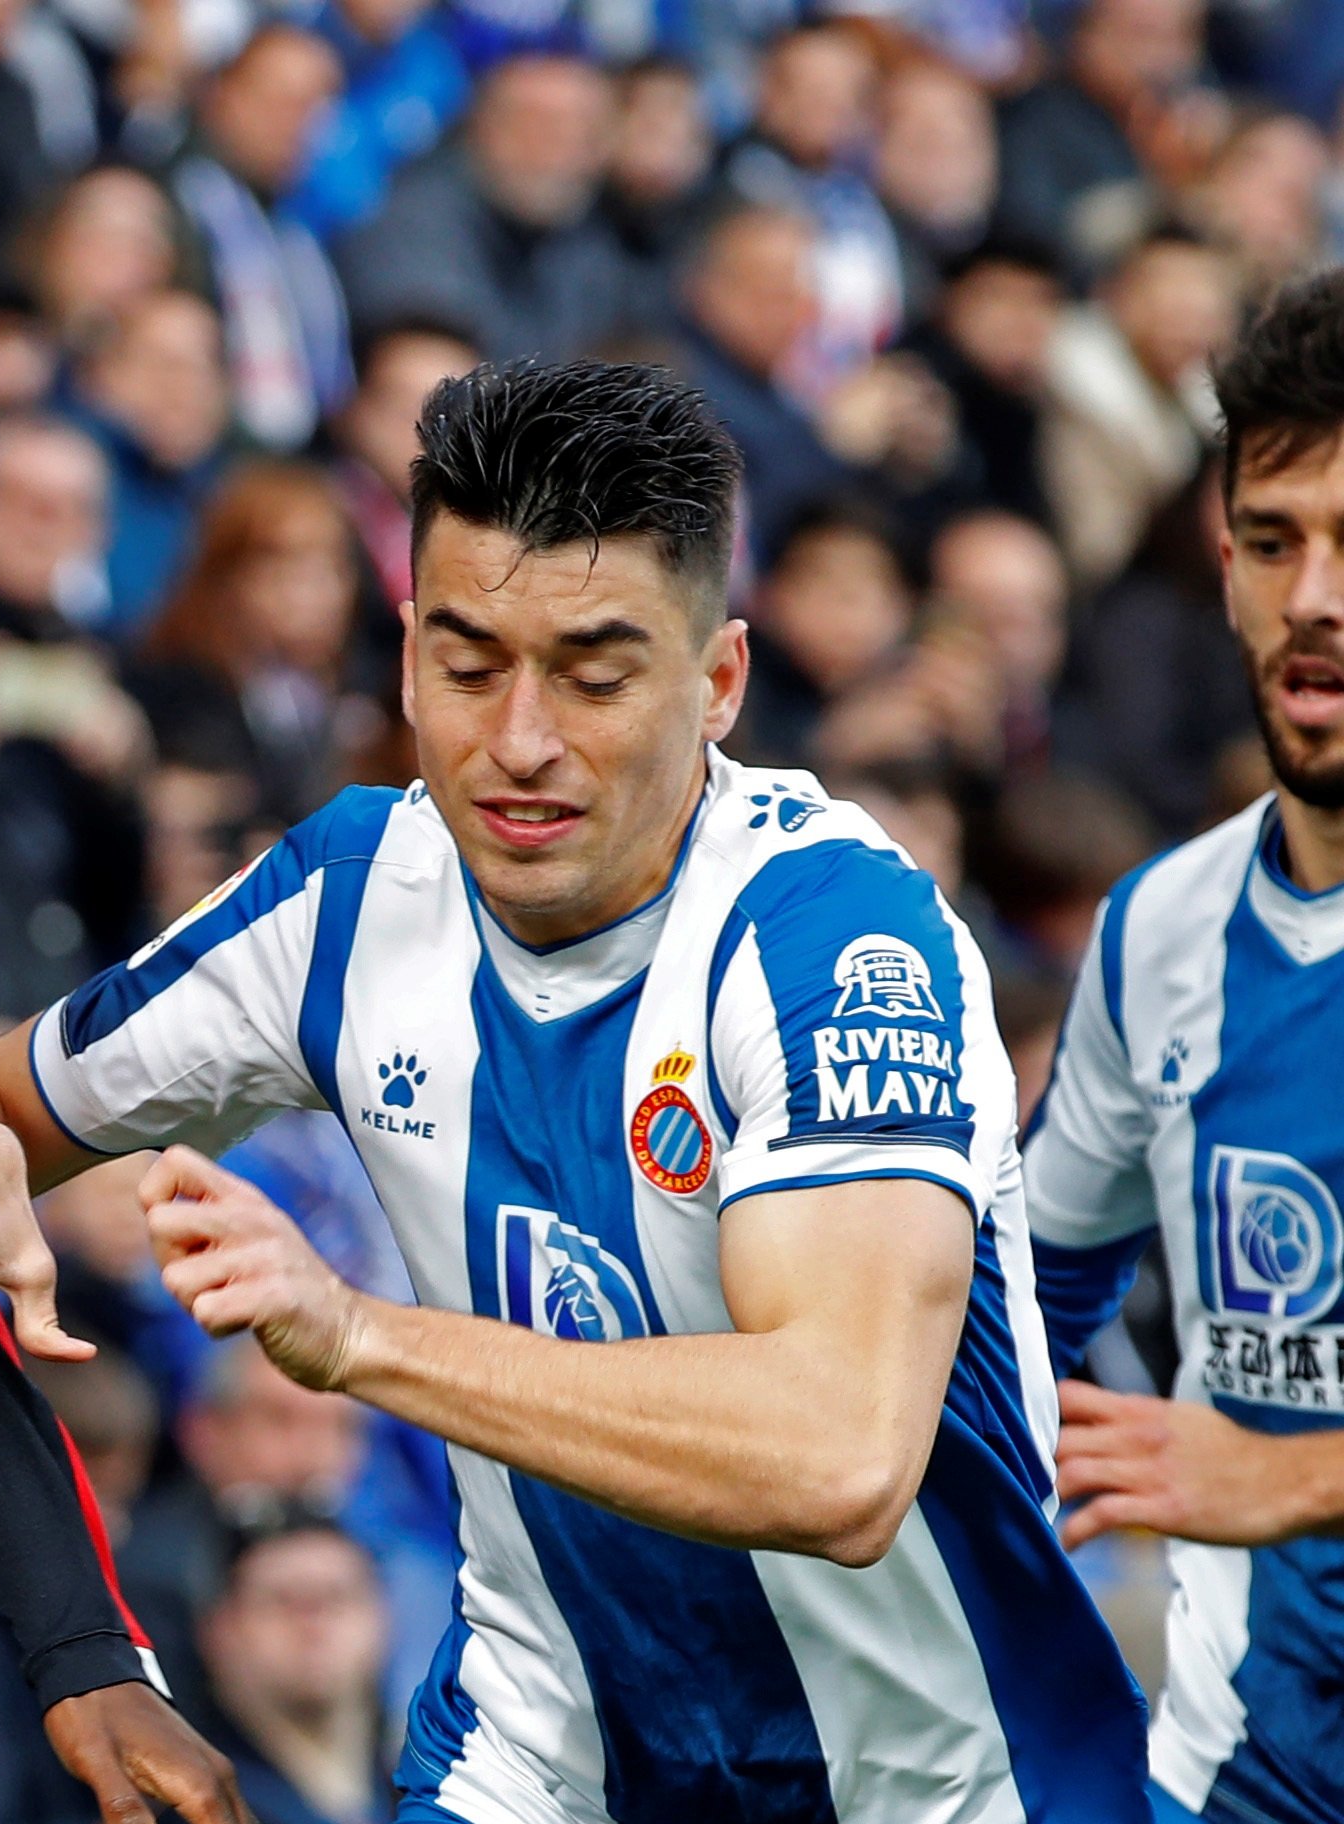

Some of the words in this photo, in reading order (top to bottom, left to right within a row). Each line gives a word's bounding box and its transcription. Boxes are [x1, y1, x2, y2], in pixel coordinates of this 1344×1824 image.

[812, 1026, 956, 1077] RIVIERA
[811, 1064, 954, 1122] MAYA
[360, 1107, 436, 1140] KELME
[1206, 1321, 1344, 1384] 乐动体
